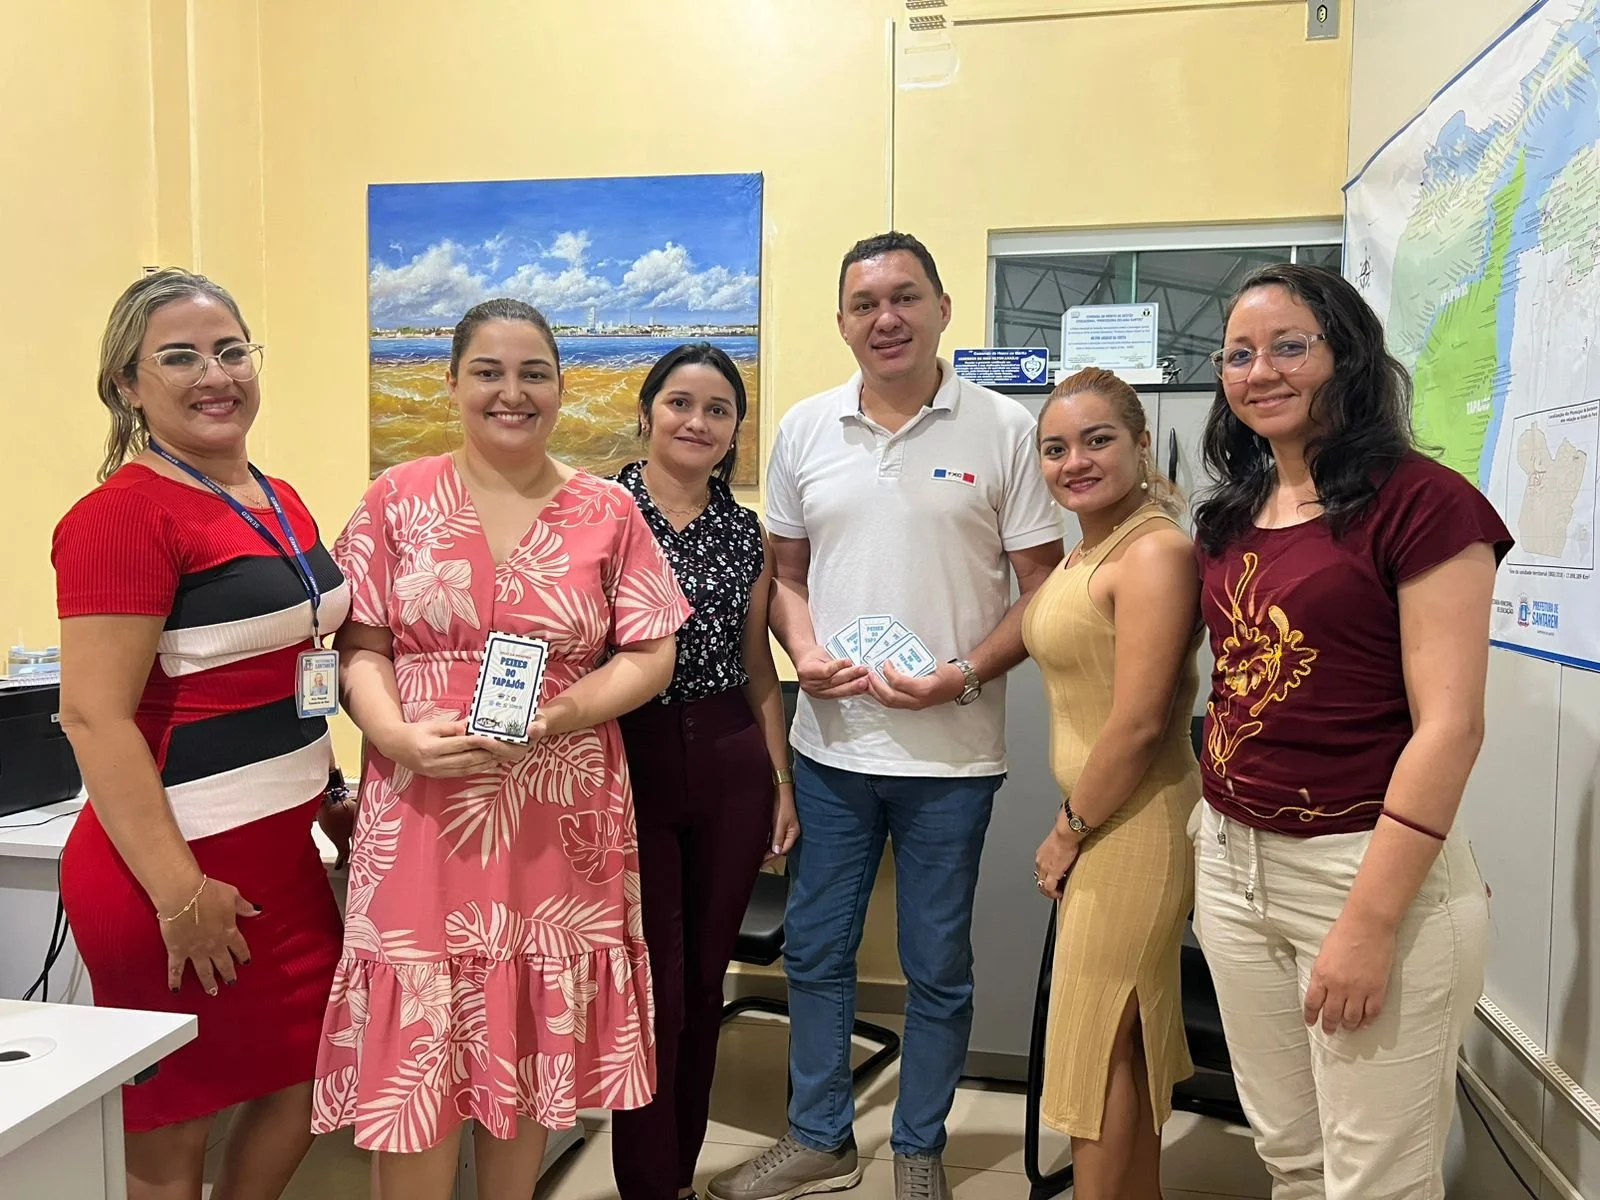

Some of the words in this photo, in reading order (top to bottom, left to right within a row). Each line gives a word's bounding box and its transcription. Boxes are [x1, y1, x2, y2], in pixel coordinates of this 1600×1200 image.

[241, 510, 261, 529] SEMED
[500, 657, 528, 669] PEIXES
[505, 668, 516, 677] DO
[492, 676, 525, 690] TAPAJÓS
